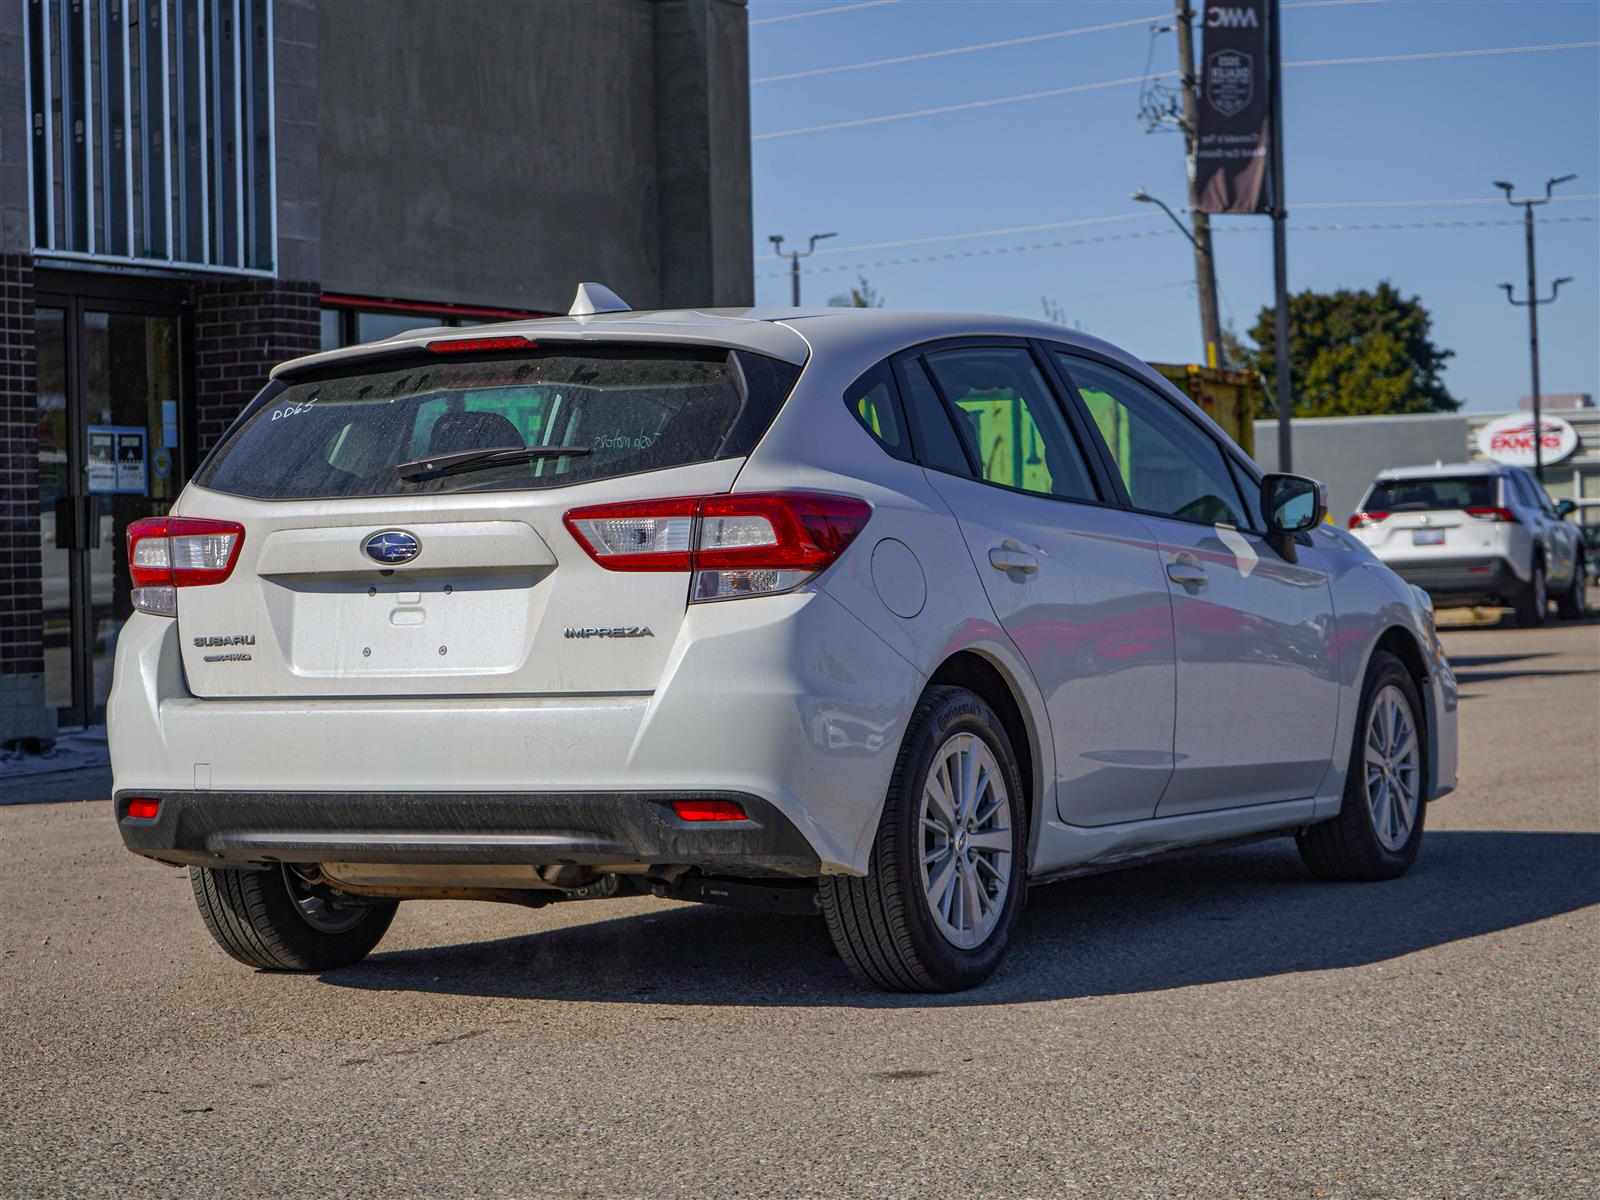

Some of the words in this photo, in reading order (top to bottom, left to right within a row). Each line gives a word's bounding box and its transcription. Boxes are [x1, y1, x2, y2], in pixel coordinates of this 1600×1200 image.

[271, 398, 318, 421] DD65
[564, 625, 656, 639] IMPREZA
[193, 634, 256, 647] SUBARU
